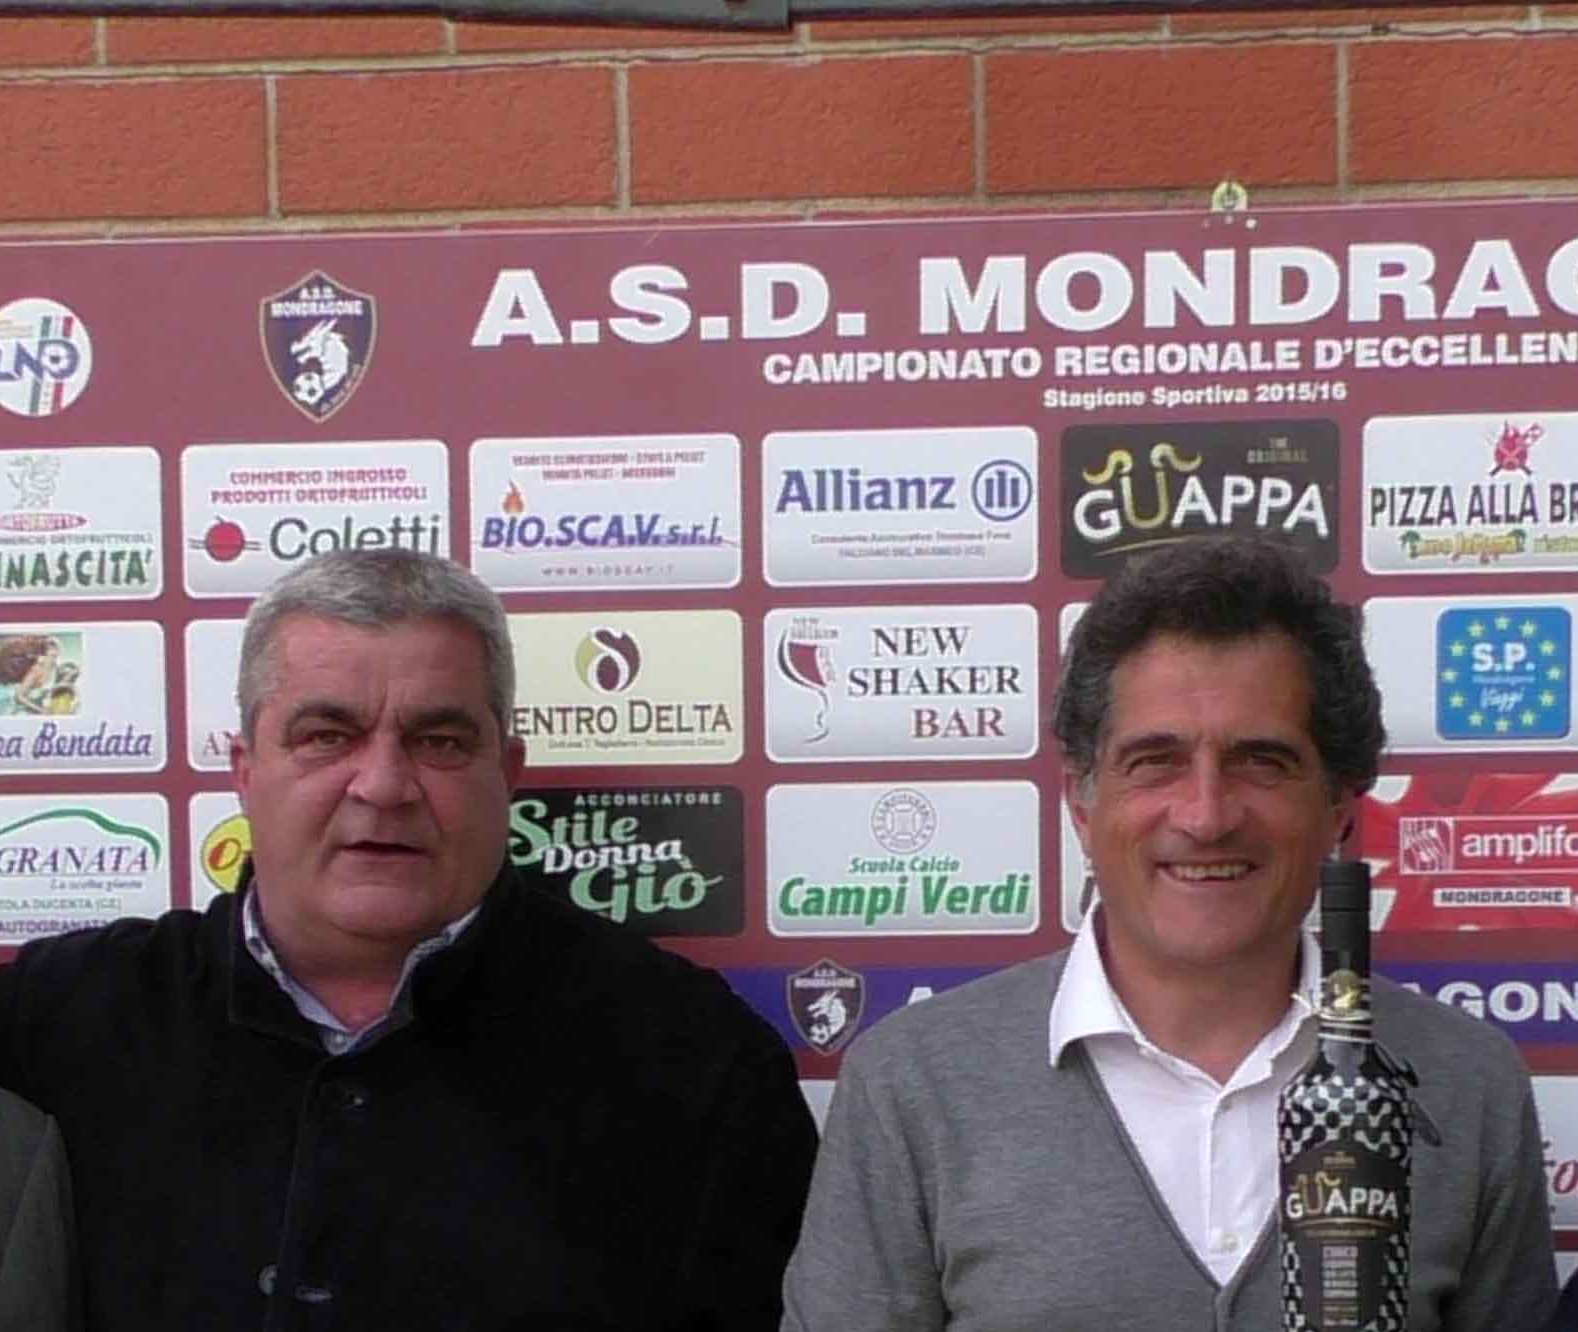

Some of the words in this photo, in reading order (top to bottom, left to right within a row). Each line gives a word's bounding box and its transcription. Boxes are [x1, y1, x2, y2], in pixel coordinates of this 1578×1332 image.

[271, 300, 364, 318] MONDRAGONE
[471, 262, 866, 347] A.S.D.
[762, 346, 1042, 385] CAMPIONATO
[1055, 338, 1301, 377] REGIONALE
[1043, 384, 1146, 410] Stagione
[1152, 383, 1249, 408] Sportiva
[1256, 381, 1348, 403] 2015/16
[229, 469, 322, 485] COMMERCIO
[327, 467, 407, 484] INGROSSO
[775, 468, 956, 513] Allianz
[211, 489, 292, 504] PRODOTTI
[296, 486, 428, 502] ORTOFRUTTICOLI
[1074, 450, 1330, 541] GUAPPA
[1371, 485, 1457, 527] PIZZA
[1466, 482, 1539, 524] ALLA
[269, 513, 440, 560] Coletti
[666, 516, 723, 545] s.r.l.
[872, 626, 970, 657] NEW
[1472, 642, 1536, 672] S.P.
[847, 665, 1022, 697] SHAKER
[512, 705, 618, 736] ENTRO
[912, 706, 1006, 739] BAR
[32, 720, 153, 760] Bendata
[574, 792, 723, 807] ACCONCIATORE
[508, 798, 639, 867] Stile
[543, 838, 683, 874] Donna
[849, 857, 905, 874] Scuola
[909, 855, 960, 873] Calcio
[32, 898, 94, 911] DUCENTA
[778, 876, 909, 926] Campi
[921, 873, 1031, 916] Verdi
[1441, 890, 1565, 904] MONDRAGONE
[1286, 1180, 1399, 1219] GUAPPA
